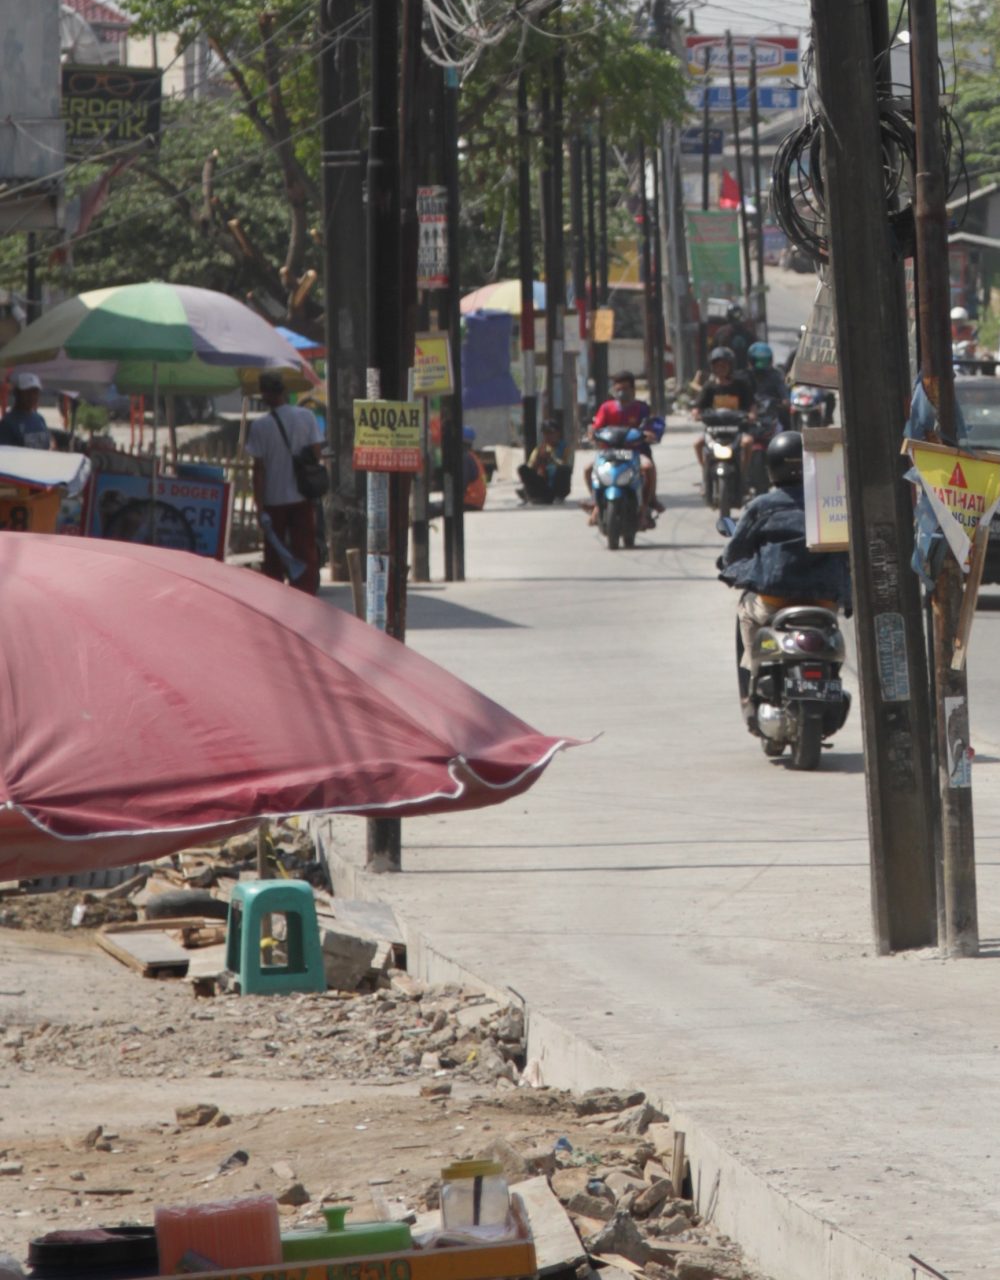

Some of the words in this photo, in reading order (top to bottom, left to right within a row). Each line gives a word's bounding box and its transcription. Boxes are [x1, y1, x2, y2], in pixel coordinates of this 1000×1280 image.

[62, 97, 149, 119] ERDANI
[358, 407, 420, 431] AQIQAH
[933, 486, 986, 512] ATI-HATI
